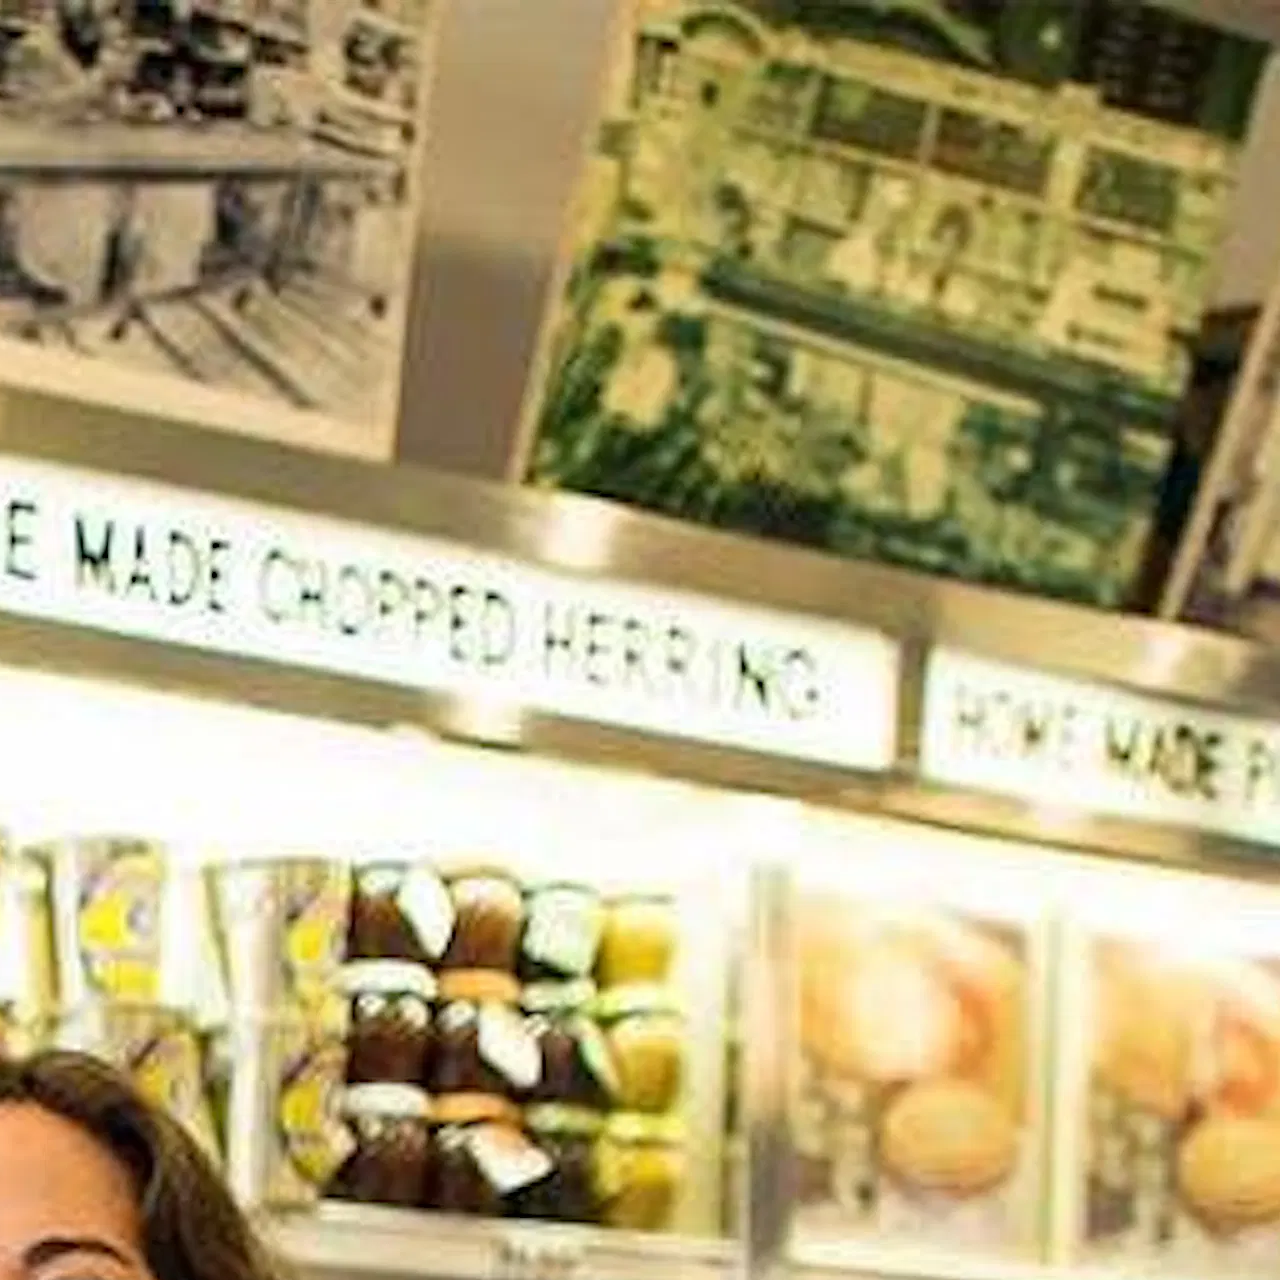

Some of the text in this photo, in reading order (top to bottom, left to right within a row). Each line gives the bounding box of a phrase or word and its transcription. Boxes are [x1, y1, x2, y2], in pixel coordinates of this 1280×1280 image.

[74, 513, 231, 613] MADE
[259, 548, 517, 667] CHOPPED
[544, 598, 824, 721] HERRING
[1104, 713, 1221, 803] MADE
